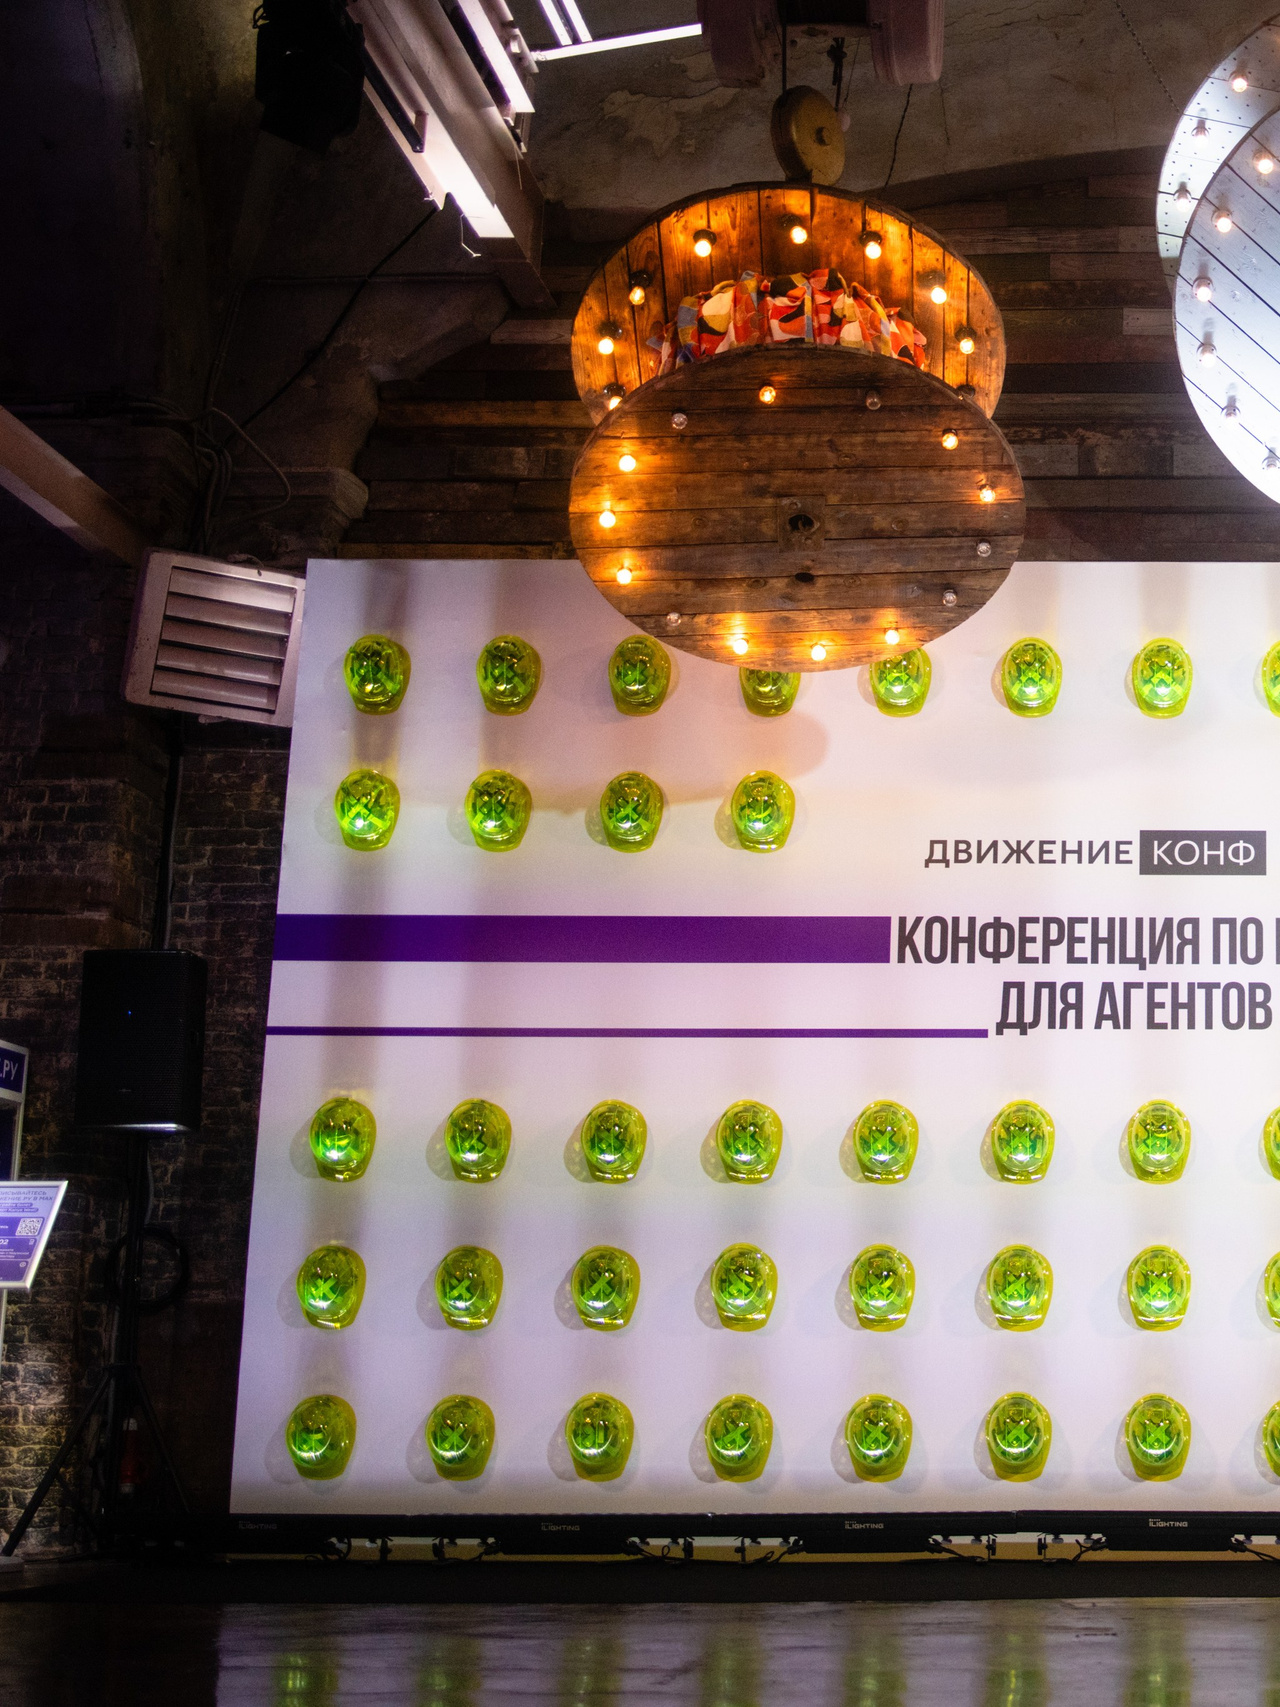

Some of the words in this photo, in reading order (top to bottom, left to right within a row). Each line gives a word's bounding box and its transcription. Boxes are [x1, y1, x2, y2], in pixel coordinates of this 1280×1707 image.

[924, 839, 1133, 868] ДВИЖЕНИЕ
[1152, 839, 1256, 866] КОНФ
[897, 915, 1200, 970] КОНФЕРЕНЦИЯ
[1212, 916, 1264, 965] ПО
[995, 981, 1084, 1035] ДЛЯ
[1093, 981, 1273, 1030] АГЕНТОВ
